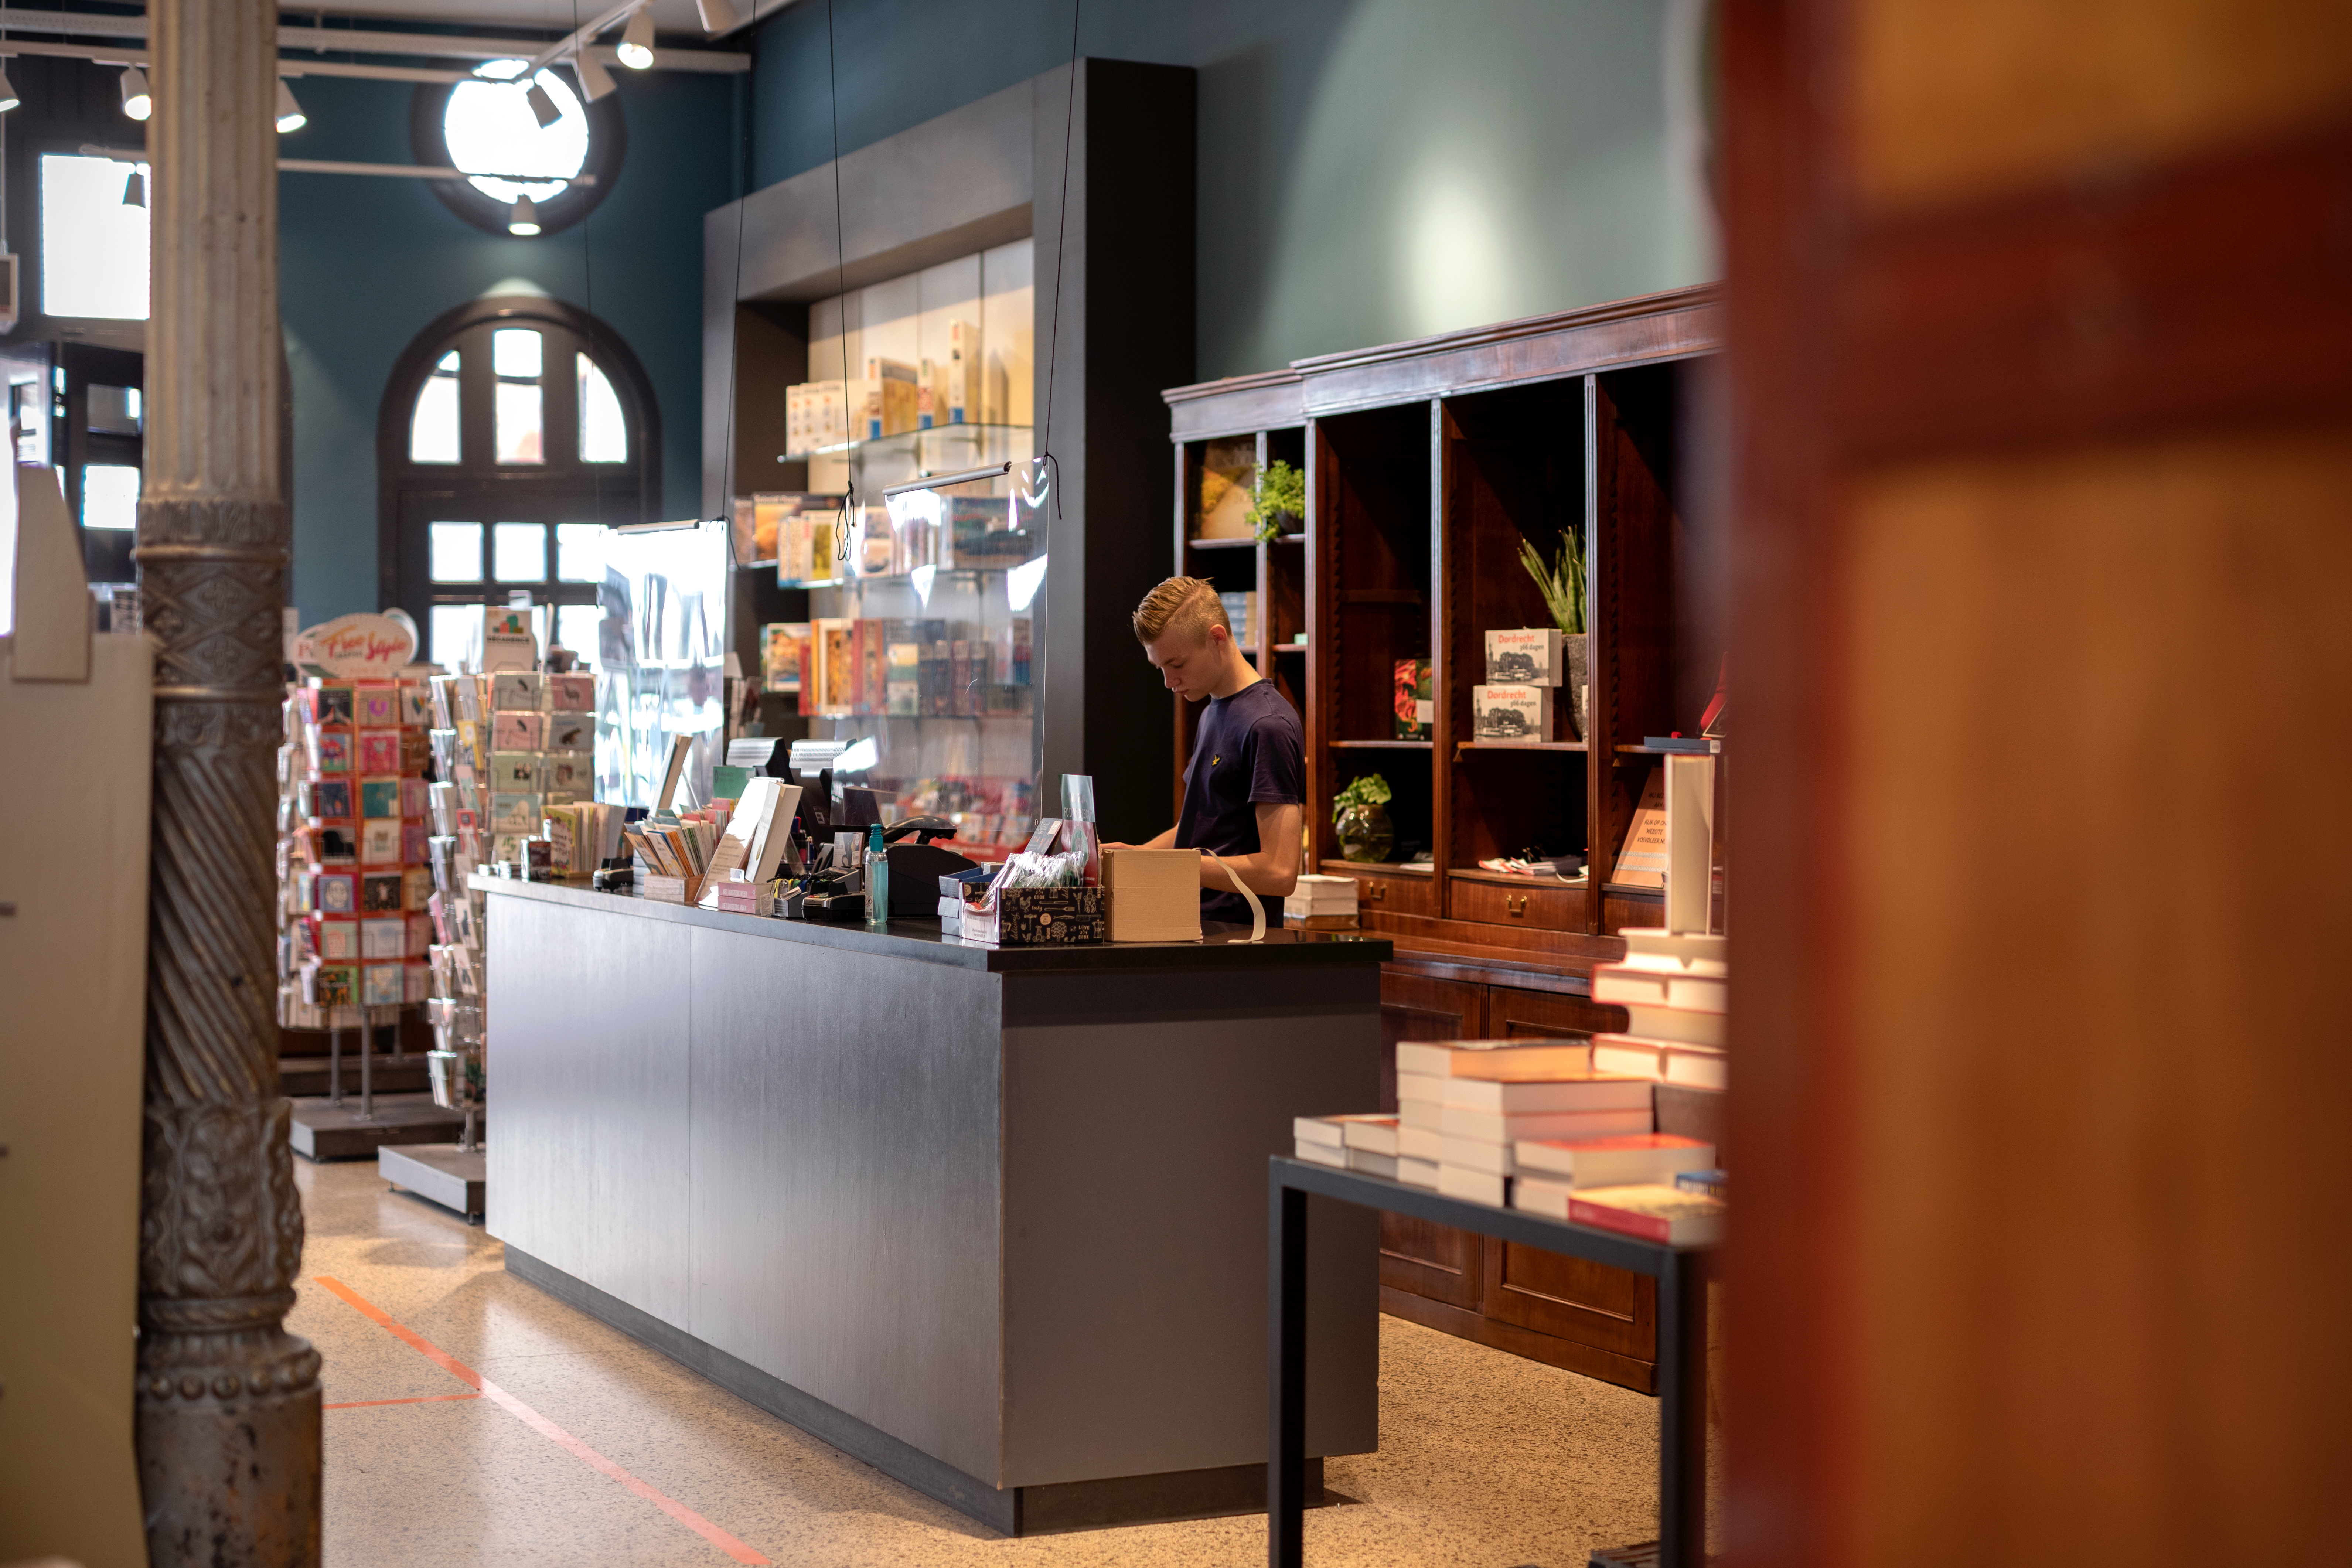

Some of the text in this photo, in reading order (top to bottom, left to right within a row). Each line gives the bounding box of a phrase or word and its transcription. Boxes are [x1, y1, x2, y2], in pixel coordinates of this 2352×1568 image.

[320, 624, 364, 659] Free
[365, 630, 407, 661] Style
[1499, 634, 1534, 644] Dordrecht
[1487, 689, 1526, 699] Dordrecht
[1520, 699, 1537, 707] dagen
[1064, 807, 1093, 818] FC DORDRECHT
